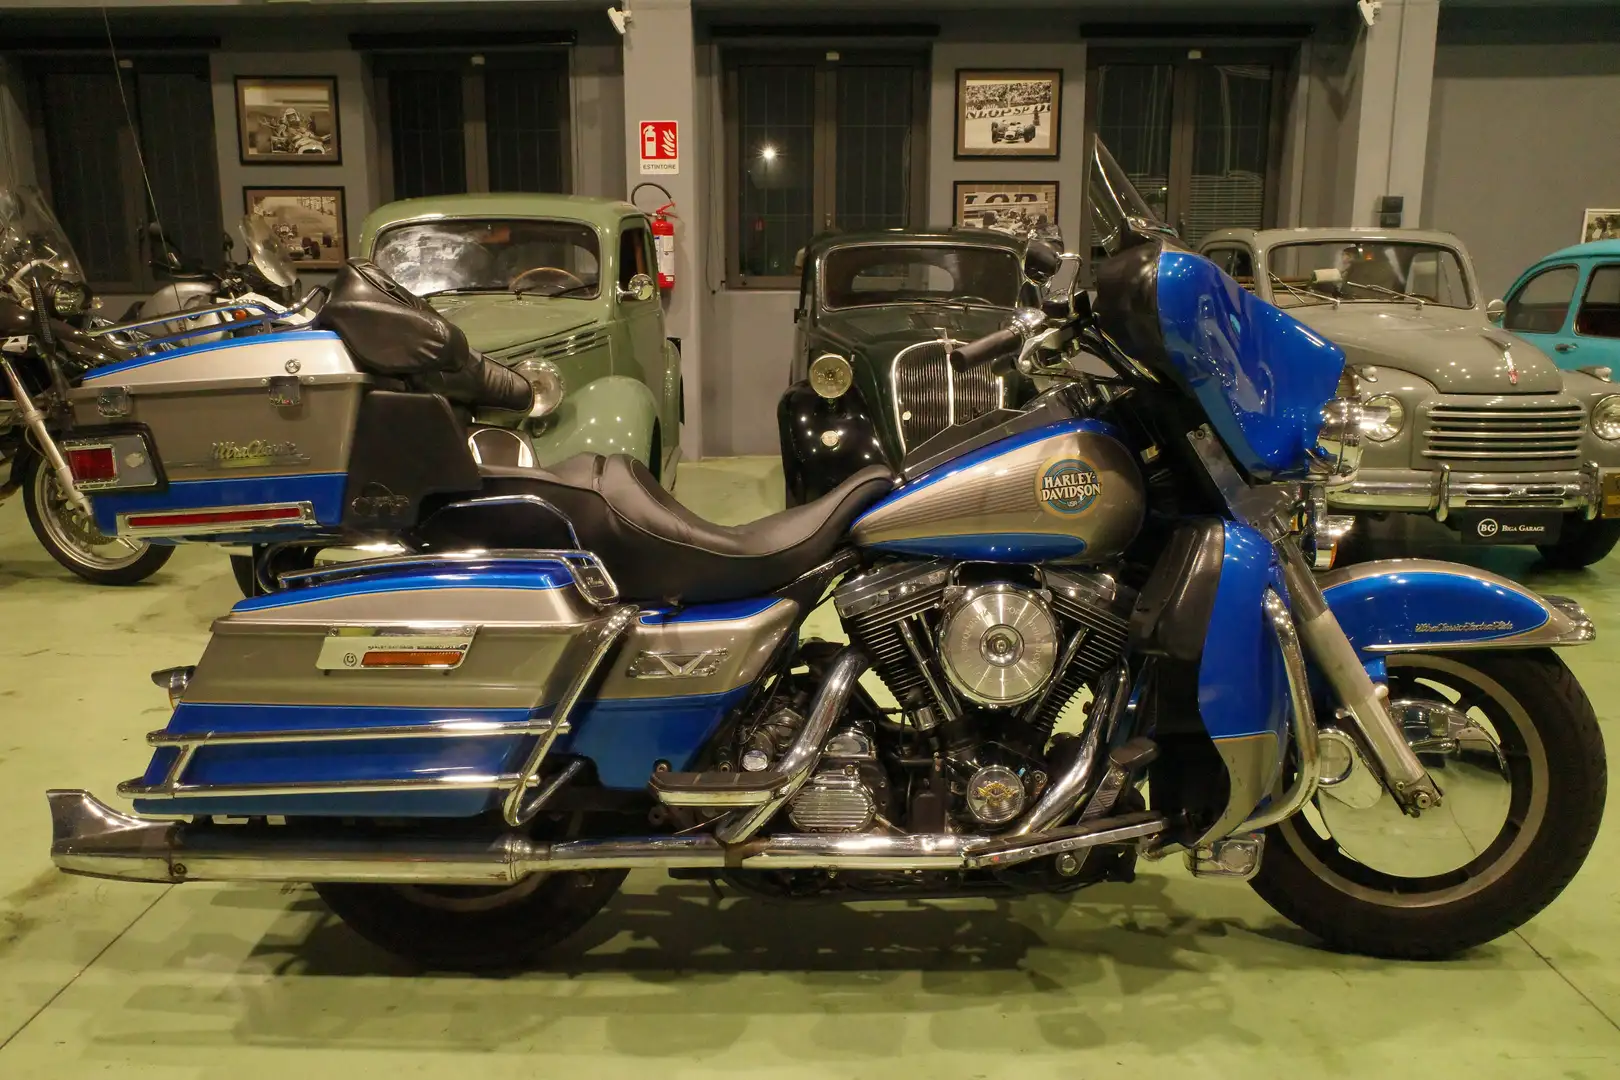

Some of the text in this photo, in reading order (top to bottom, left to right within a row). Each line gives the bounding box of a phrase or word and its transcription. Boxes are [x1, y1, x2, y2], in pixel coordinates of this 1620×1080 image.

[1043, 471, 1096, 489] HARLEY-
[1041, 483, 1101, 502] DAVIDSON
[1480, 524, 1495, 532] BG
